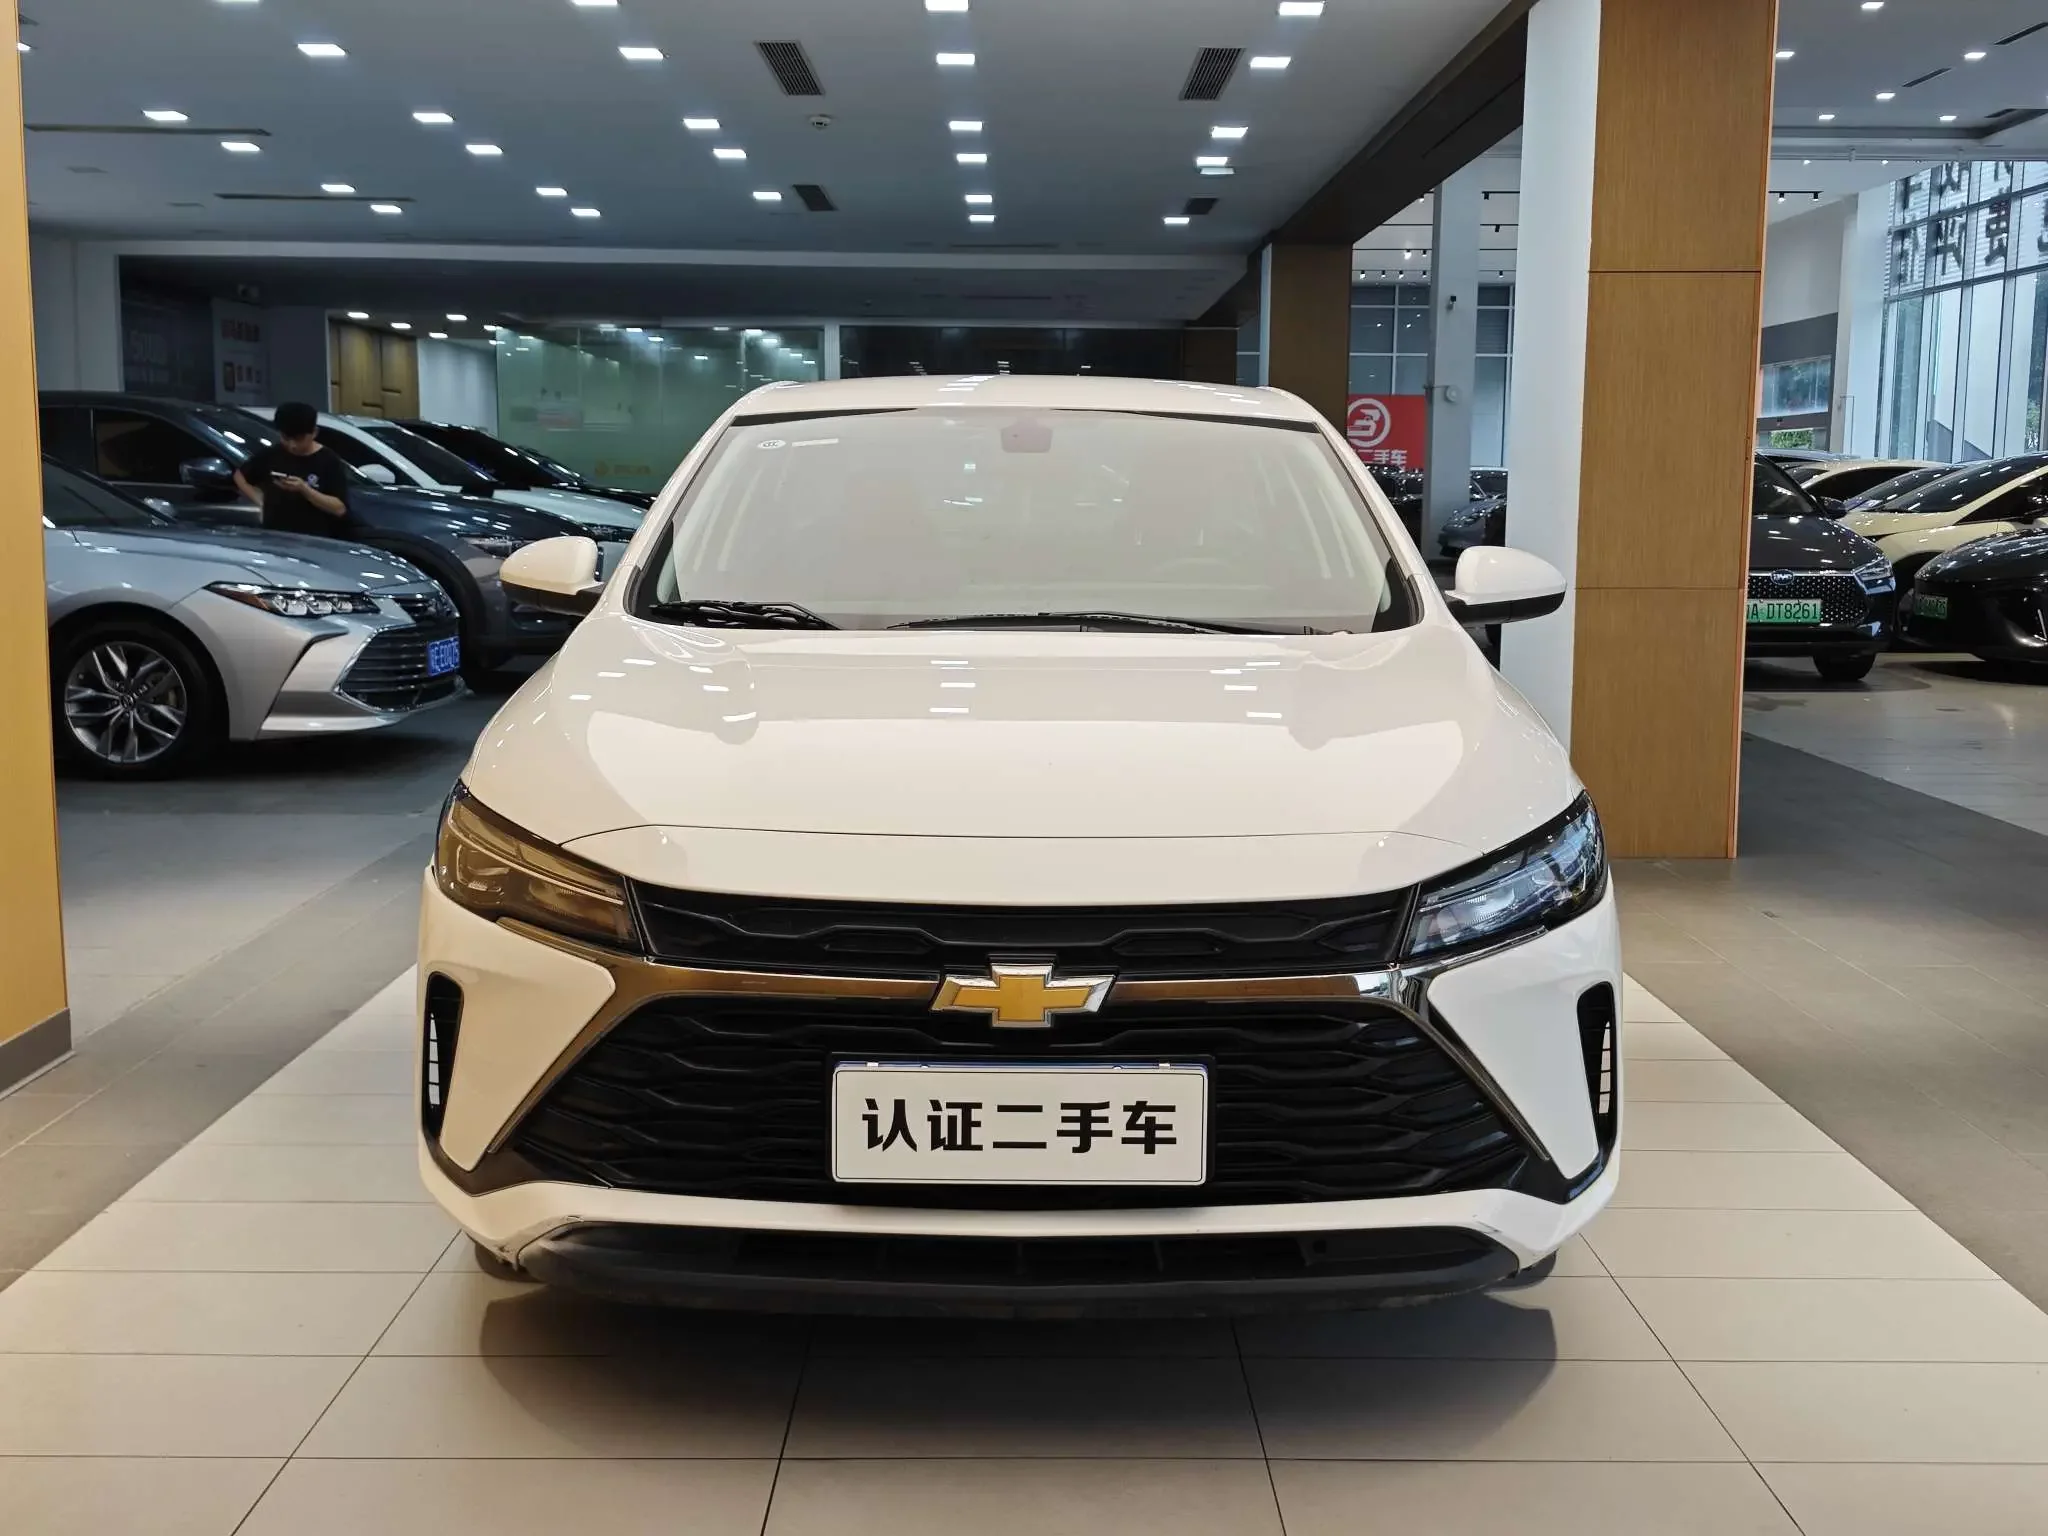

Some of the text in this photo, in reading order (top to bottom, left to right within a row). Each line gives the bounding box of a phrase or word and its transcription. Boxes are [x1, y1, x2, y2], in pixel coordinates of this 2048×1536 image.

[862, 1098, 1177, 1155] 认证二手车
